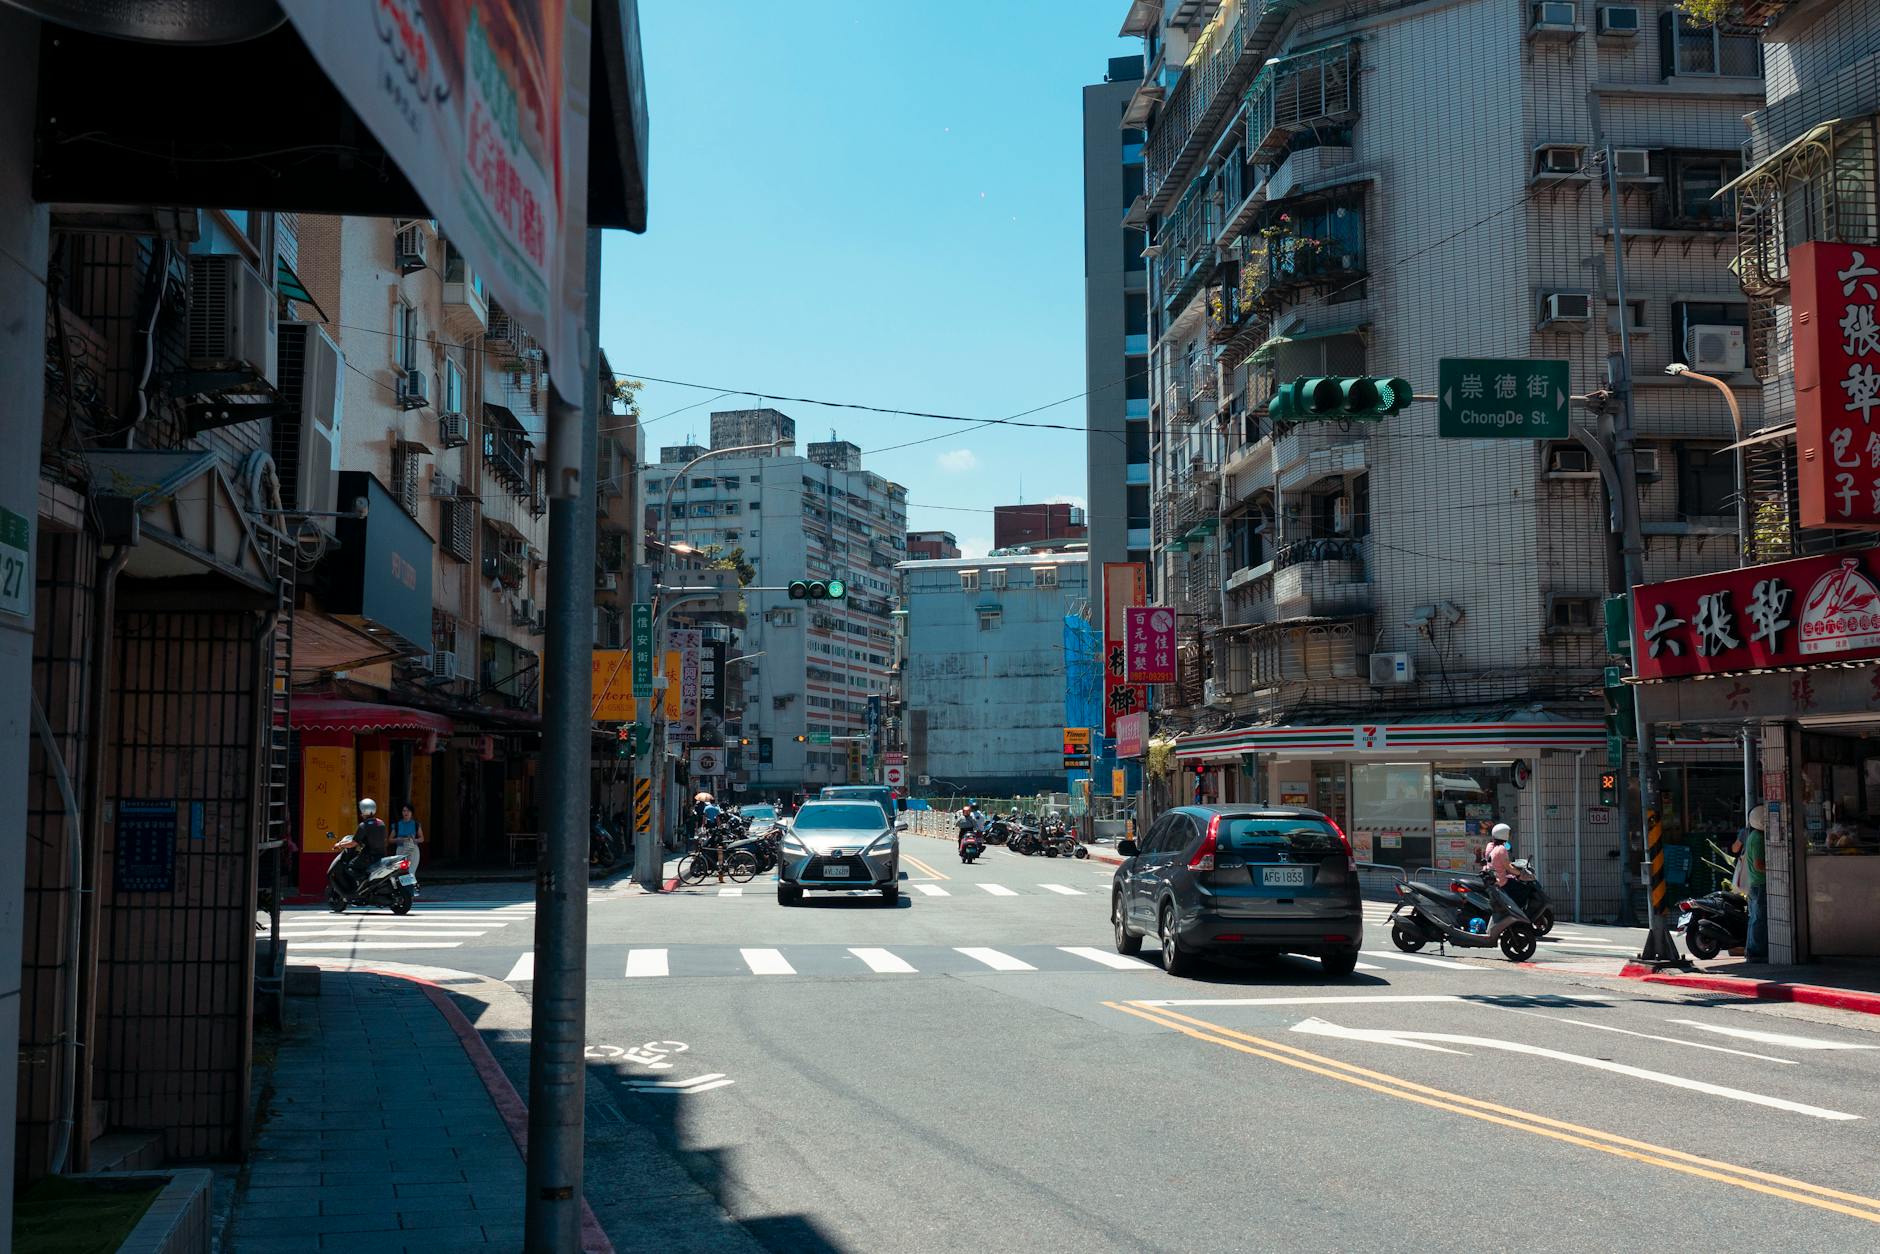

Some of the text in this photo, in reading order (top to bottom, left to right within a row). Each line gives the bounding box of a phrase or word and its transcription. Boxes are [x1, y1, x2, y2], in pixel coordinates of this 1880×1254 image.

[1460, 373, 1549, 399] 崇德街
[1460, 410, 1550, 428] ChongDe St.
[1828, 426, 1862, 518] 包子
[1643, 577, 1794, 659] 六張犁
[637, 617, 649, 663] 信安街
[1134, 612, 1148, 671] 百元理髮
[1154, 634, 1169, 668] 佳佳
[1602, 775, 1614, 789] 32
